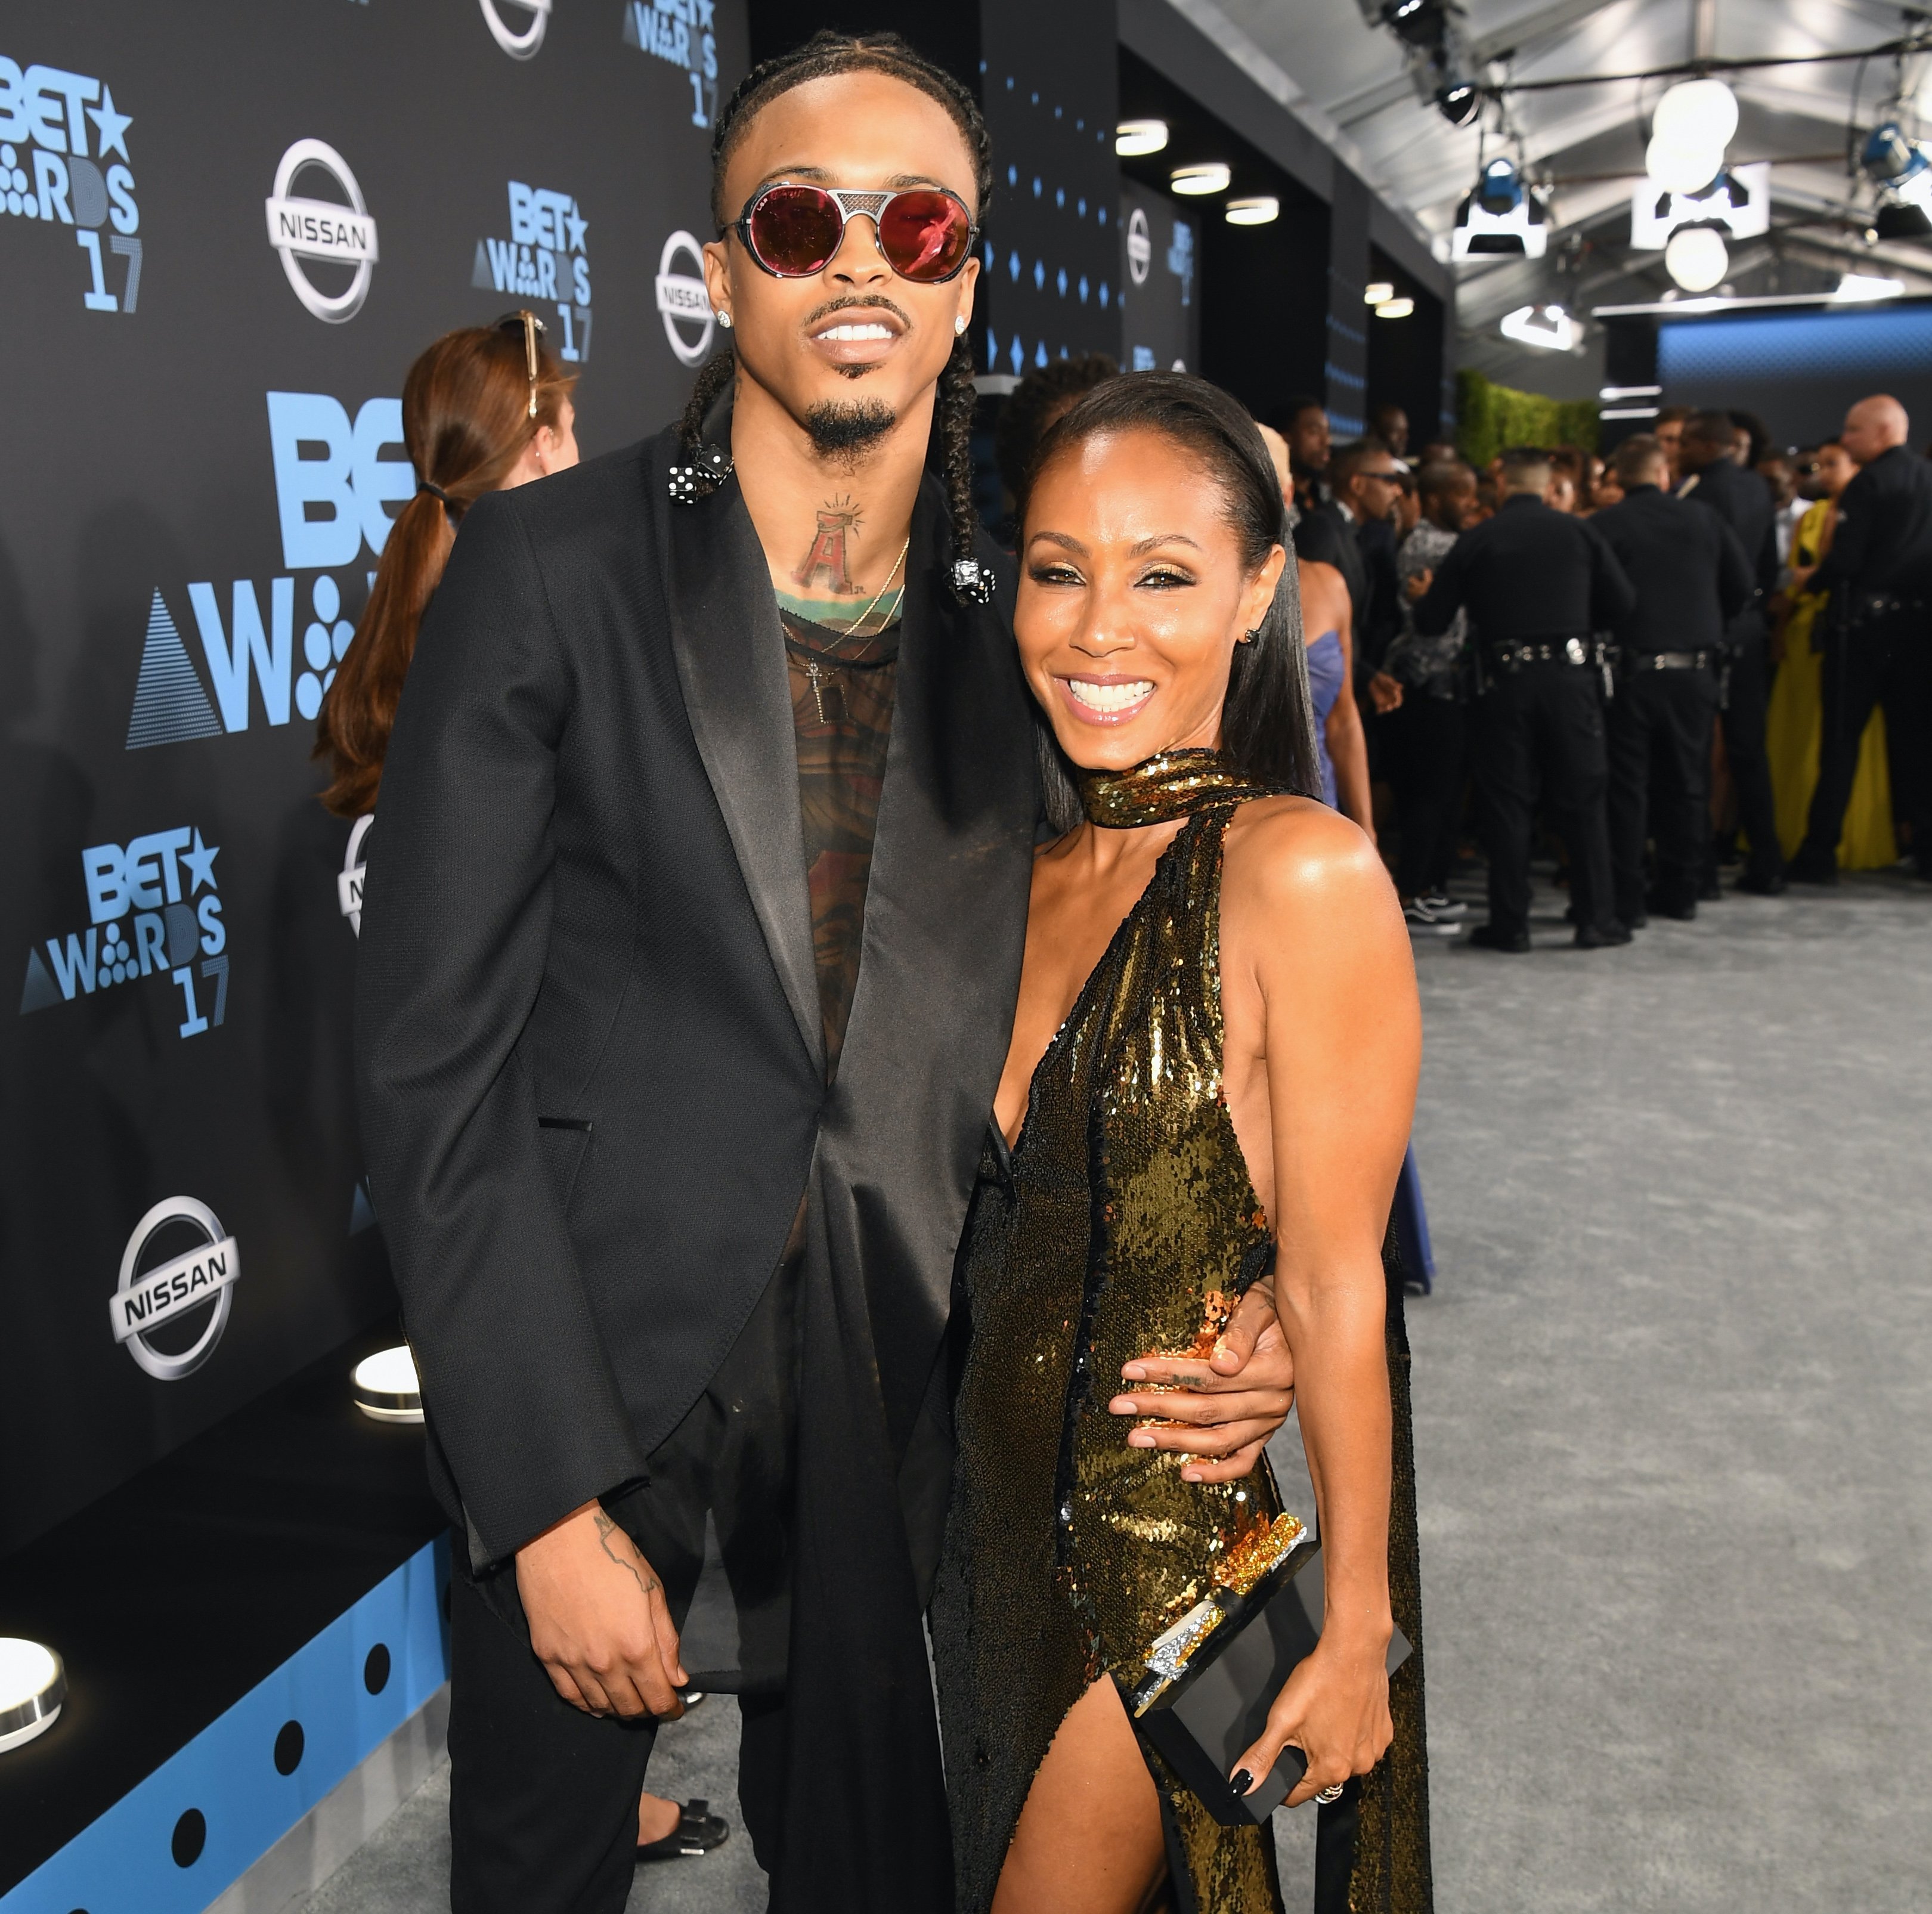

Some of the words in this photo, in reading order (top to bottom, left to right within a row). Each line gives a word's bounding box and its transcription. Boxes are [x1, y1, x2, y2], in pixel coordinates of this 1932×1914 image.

[280, 212, 367, 250] NISSAN
[508, 181, 572, 252] BET
[76, 229, 143, 313] 17
[557, 302, 592, 363] 17
[266, 391, 417, 569] BE
[82, 826, 191, 924] BET
[172, 955, 230, 1039] 17
[124, 1252, 227, 1326] NISSAN
